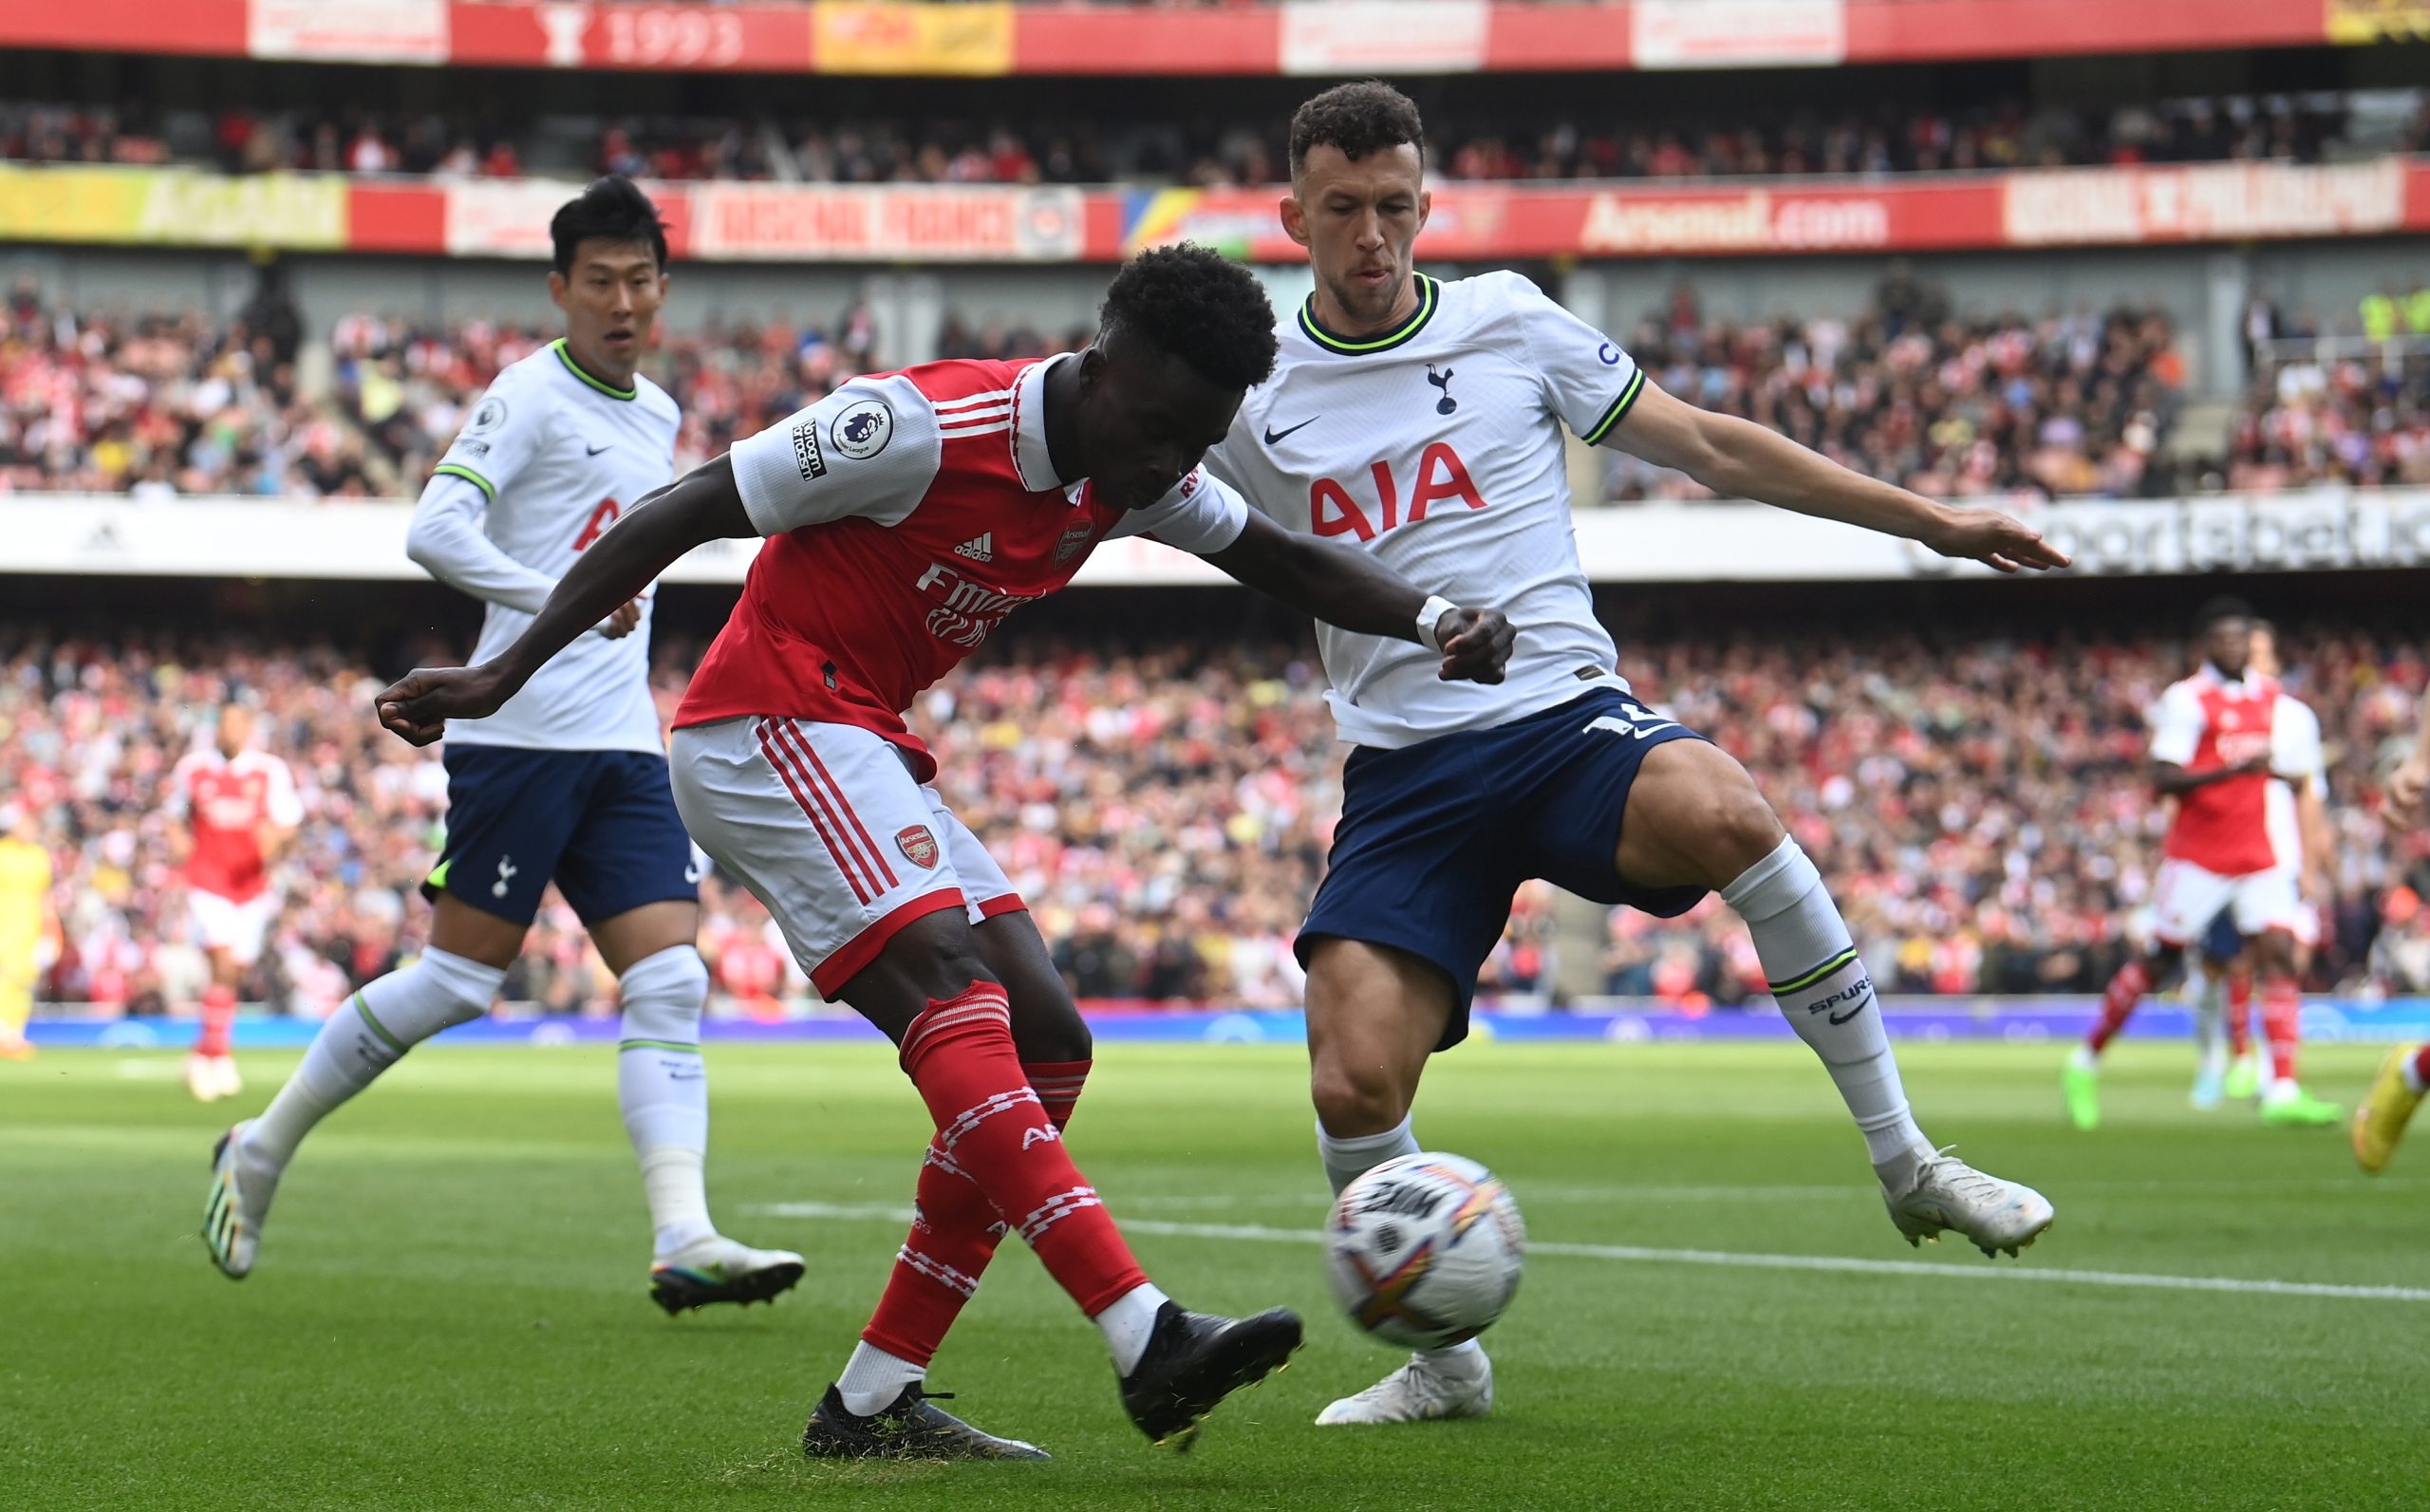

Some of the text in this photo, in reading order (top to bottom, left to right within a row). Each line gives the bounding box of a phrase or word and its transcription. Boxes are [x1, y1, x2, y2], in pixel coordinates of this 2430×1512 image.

[607, 9, 743, 66] 1993
[1580, 190, 1888, 252] Arsenal.com
[794, 438, 813, 481] racism
[805, 435, 822, 472] room
[1311, 442, 1488, 543] AIA
[954, 545, 993, 563] adidas
